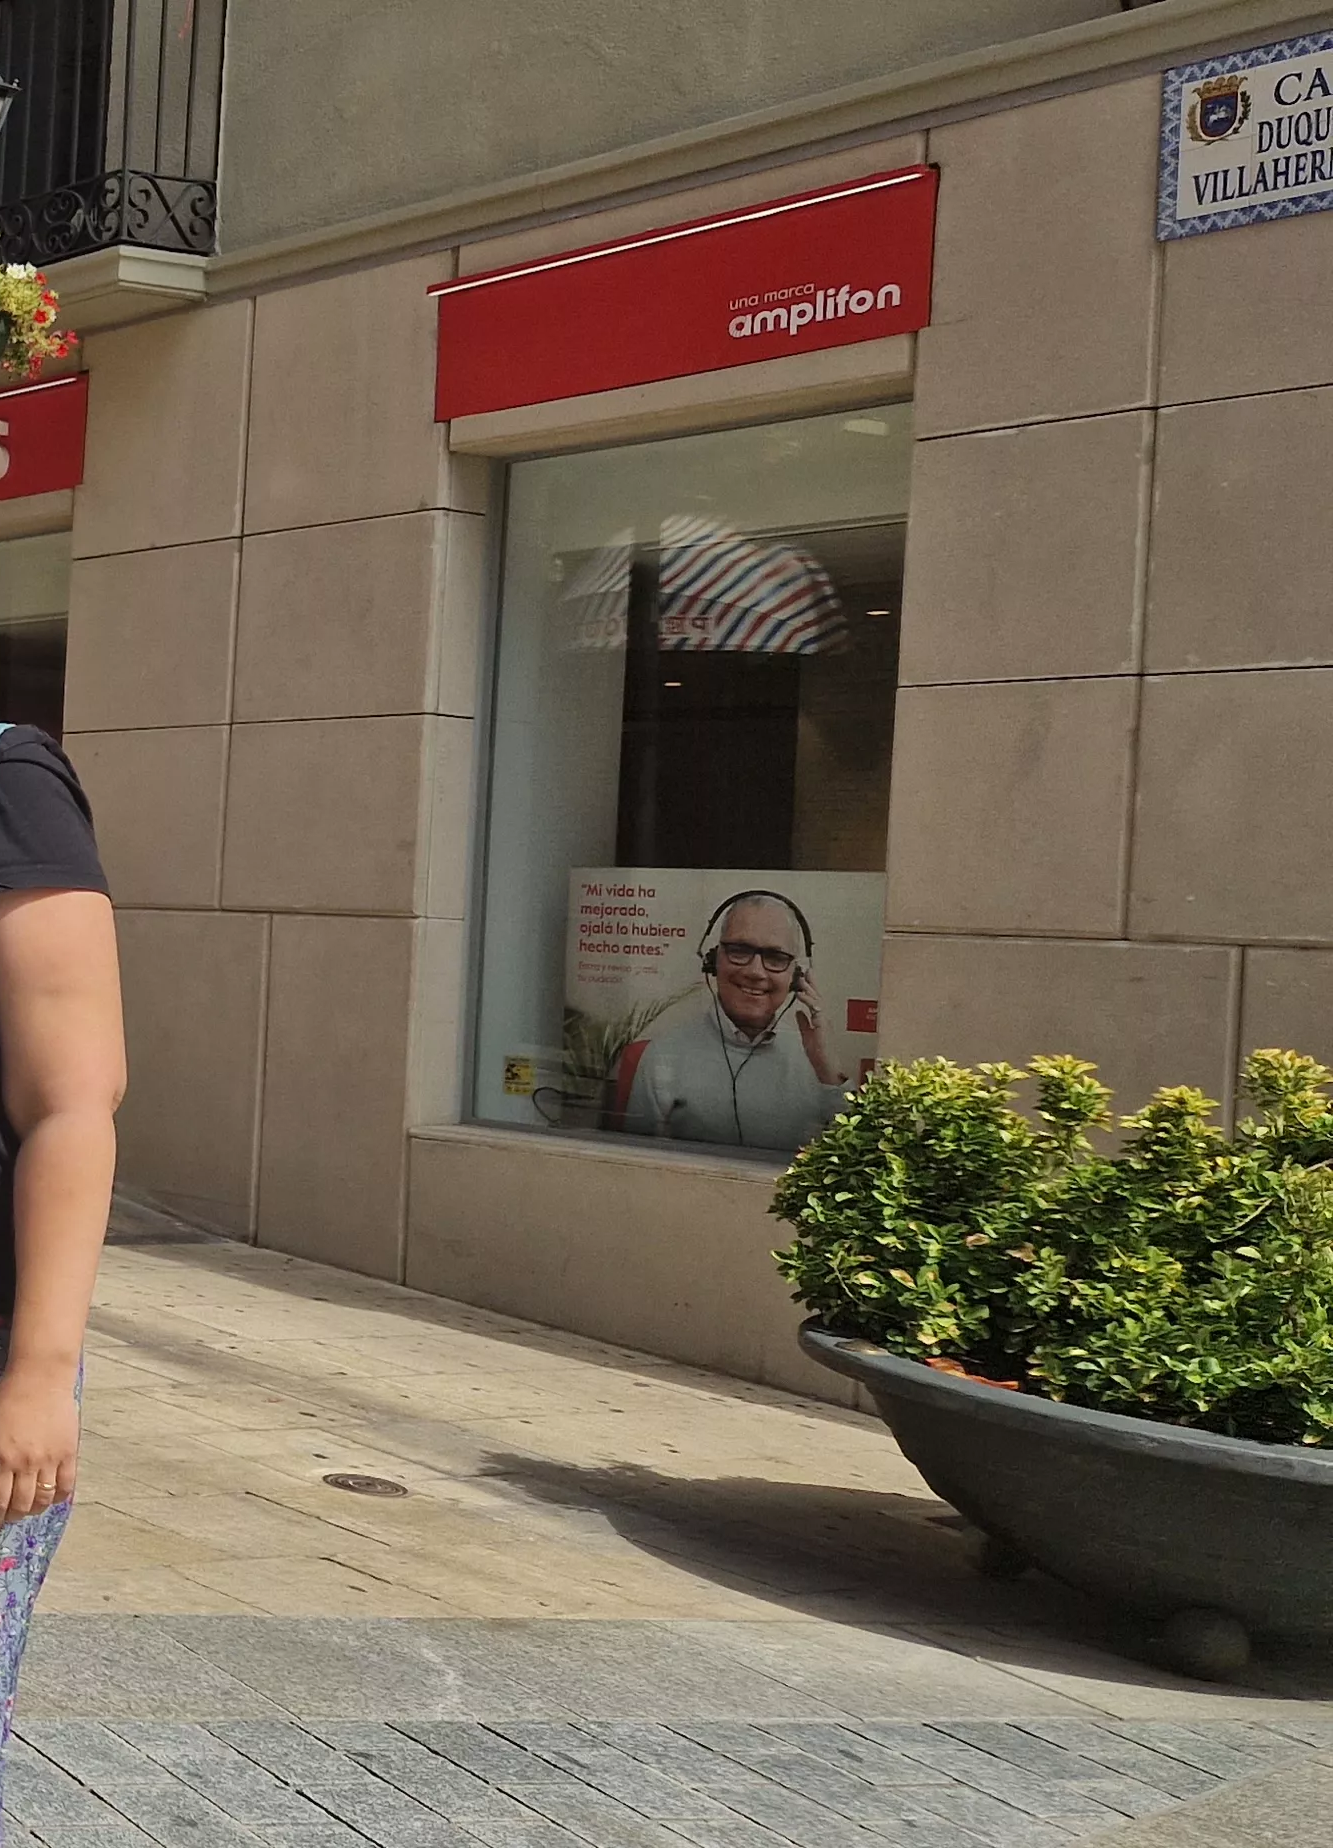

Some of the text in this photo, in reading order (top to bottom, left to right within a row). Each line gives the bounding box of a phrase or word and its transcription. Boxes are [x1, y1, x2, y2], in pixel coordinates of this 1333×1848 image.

[1274, 67, 1333, 106] CA
[729, 283, 815, 311] una marca
[728, 283, 901, 338] amplifon
[605, 884, 634, 898] vida
[638, 884, 656, 898] ha
[580, 903, 649, 919] mejorado,
[580, 921, 686, 938] ojalá lo hubiera
[579, 939, 620, 954] hecho
